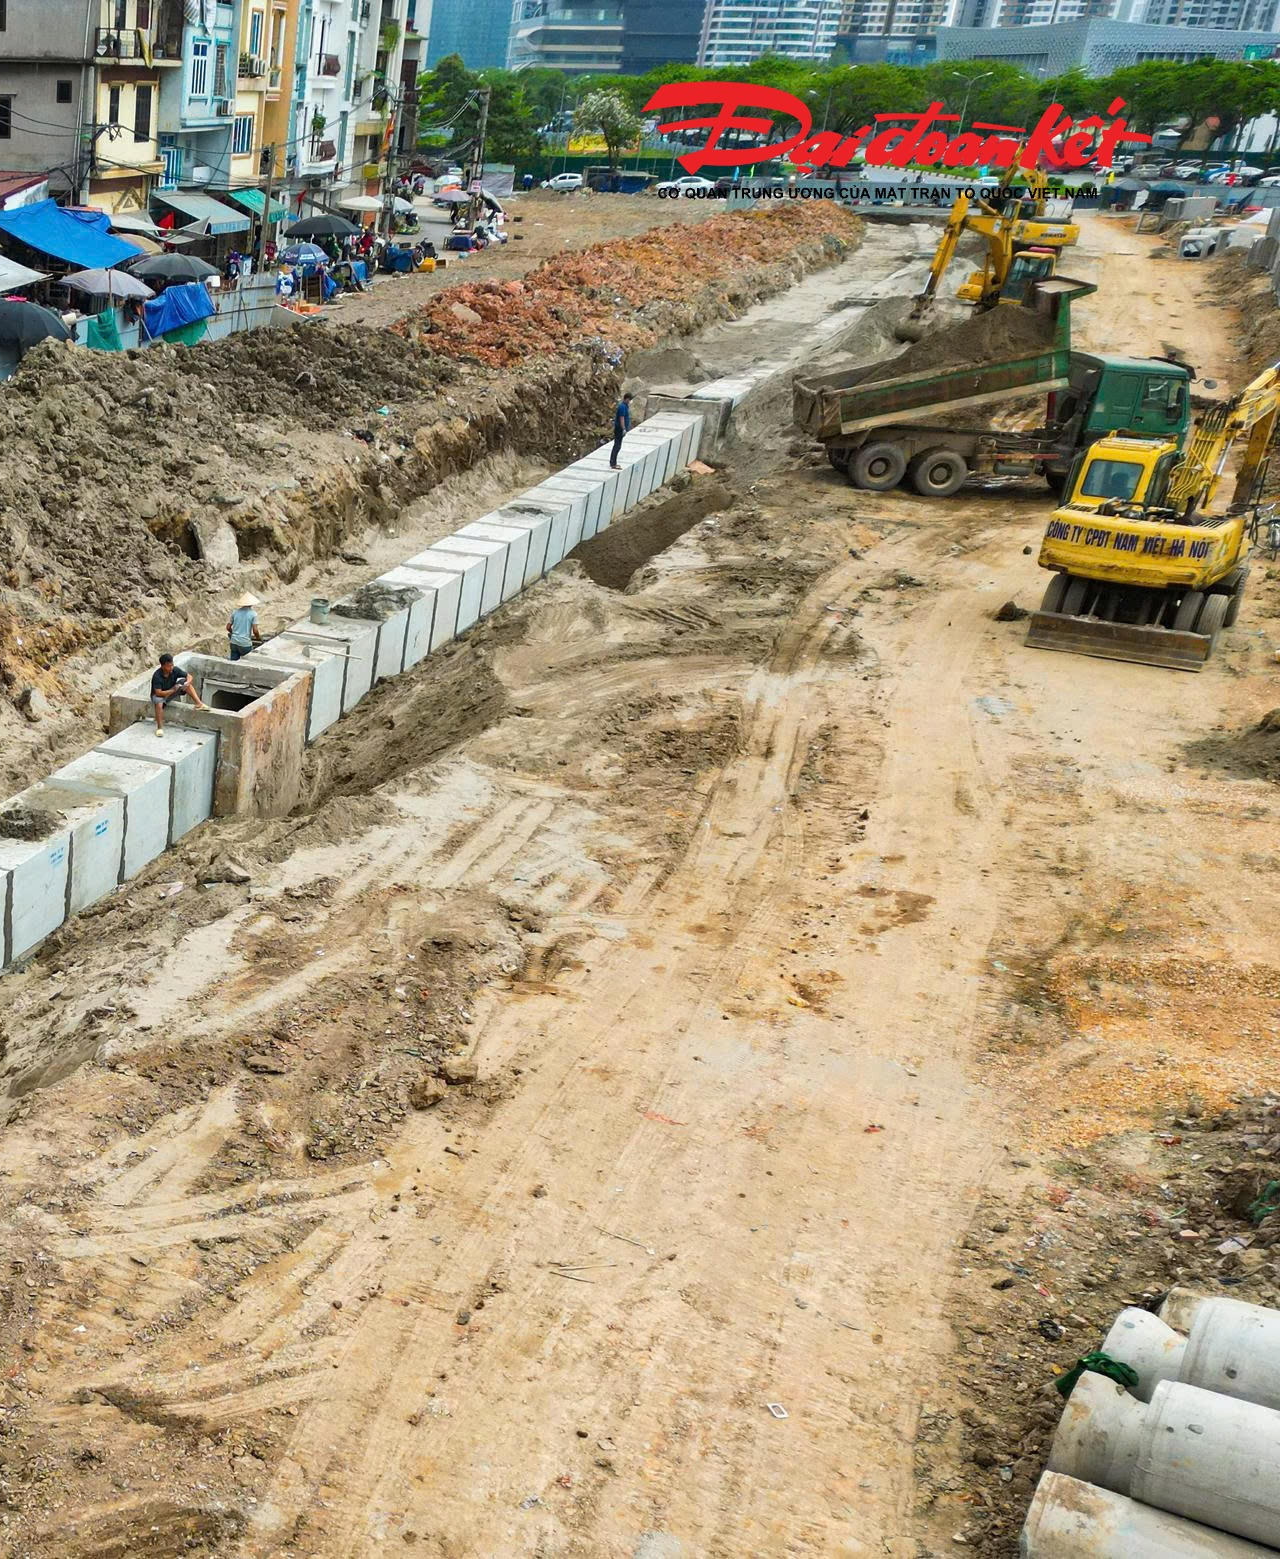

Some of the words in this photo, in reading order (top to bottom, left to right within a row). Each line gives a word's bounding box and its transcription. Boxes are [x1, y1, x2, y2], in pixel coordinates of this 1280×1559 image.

[1046, 518, 1070, 540] CÔNG
[1070, 525, 1085, 543] TY
[1112, 532, 1140, 553] NAM
